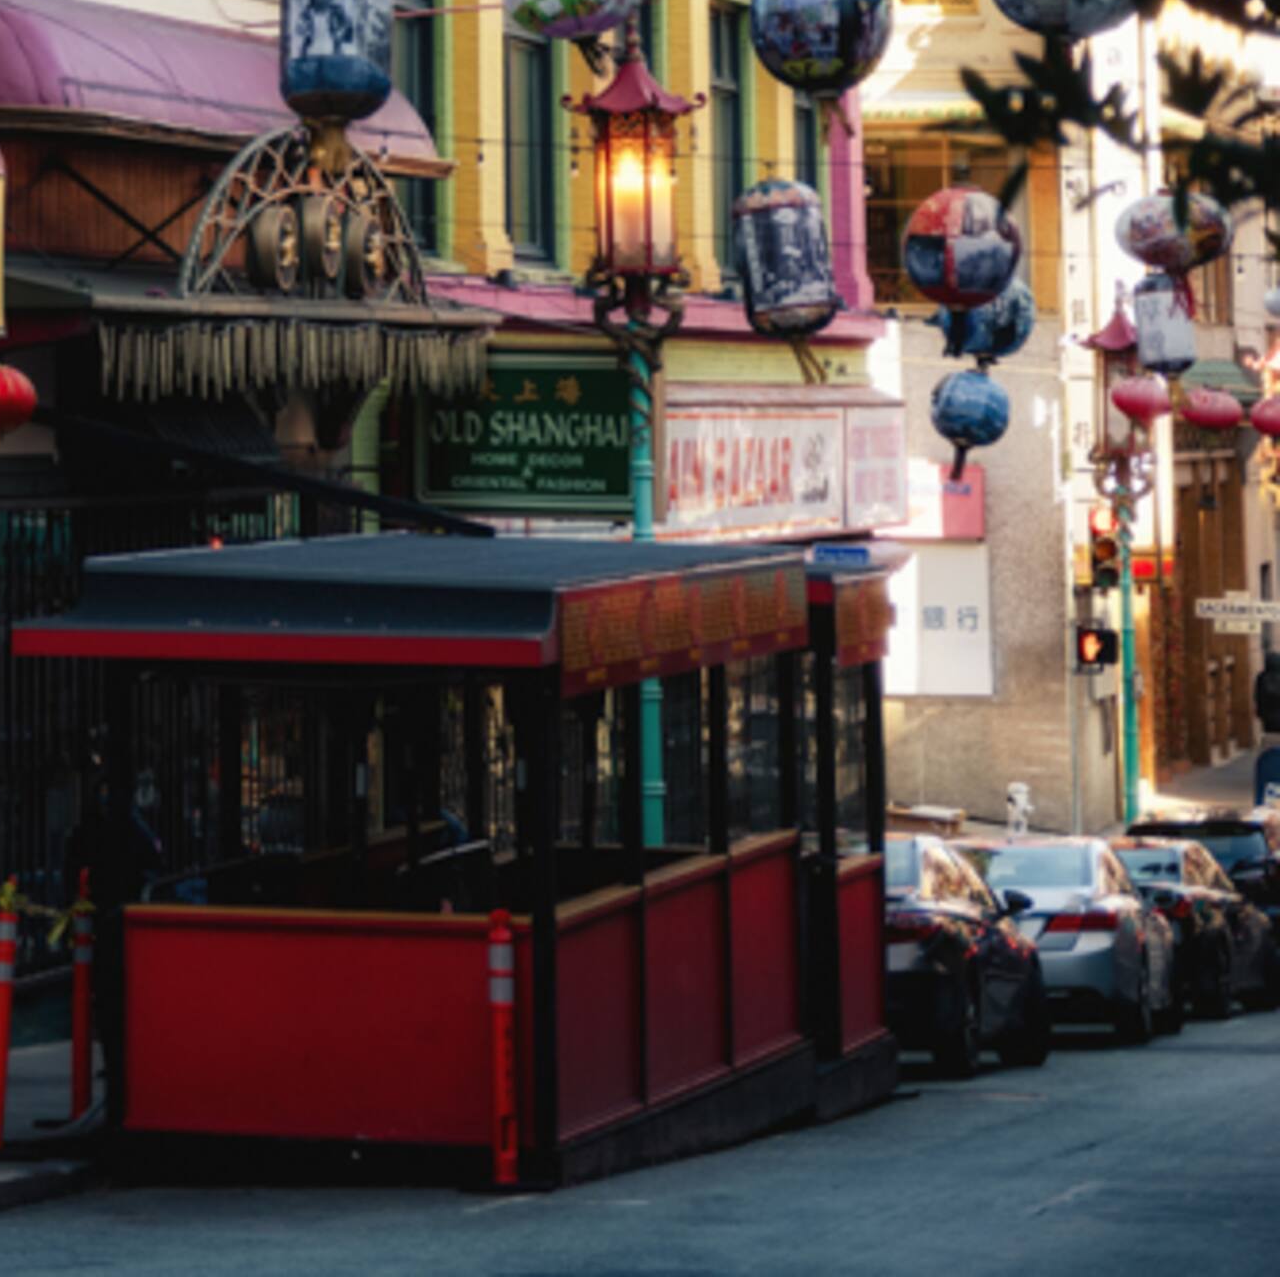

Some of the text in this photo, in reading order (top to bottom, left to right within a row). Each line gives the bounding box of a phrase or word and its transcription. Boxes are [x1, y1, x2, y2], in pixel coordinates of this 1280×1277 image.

[431, 410, 630, 447] OLD SHANGHAI
[471, 452, 585, 468] HOME DECOR
[451, 475, 607, 493] ORIENTAL FASHION
